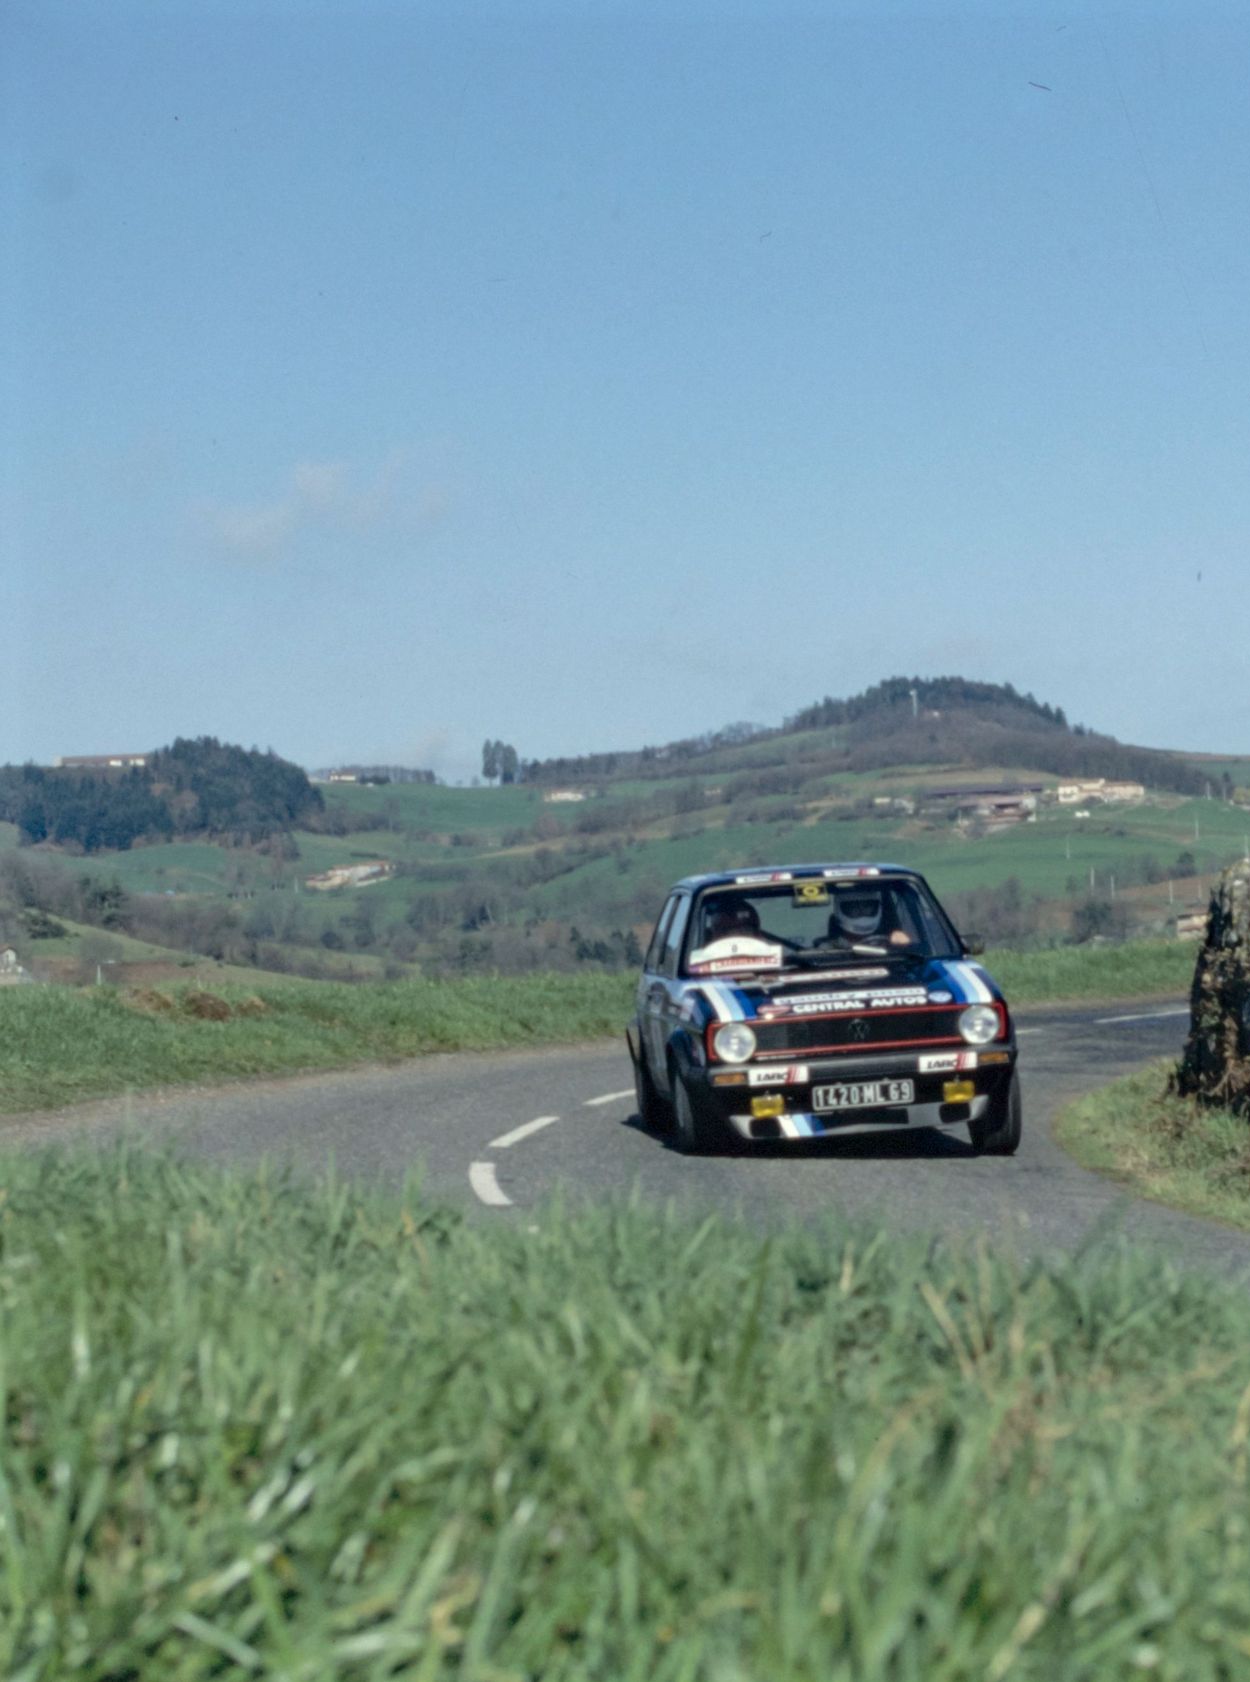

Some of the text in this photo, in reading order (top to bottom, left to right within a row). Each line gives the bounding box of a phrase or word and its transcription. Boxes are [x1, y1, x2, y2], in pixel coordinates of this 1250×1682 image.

[792, 999, 866, 1013] CENTRAL
[870, 996, 927, 1007] AUTOS
[816, 1081, 910, 1108] 1420 ML 69
